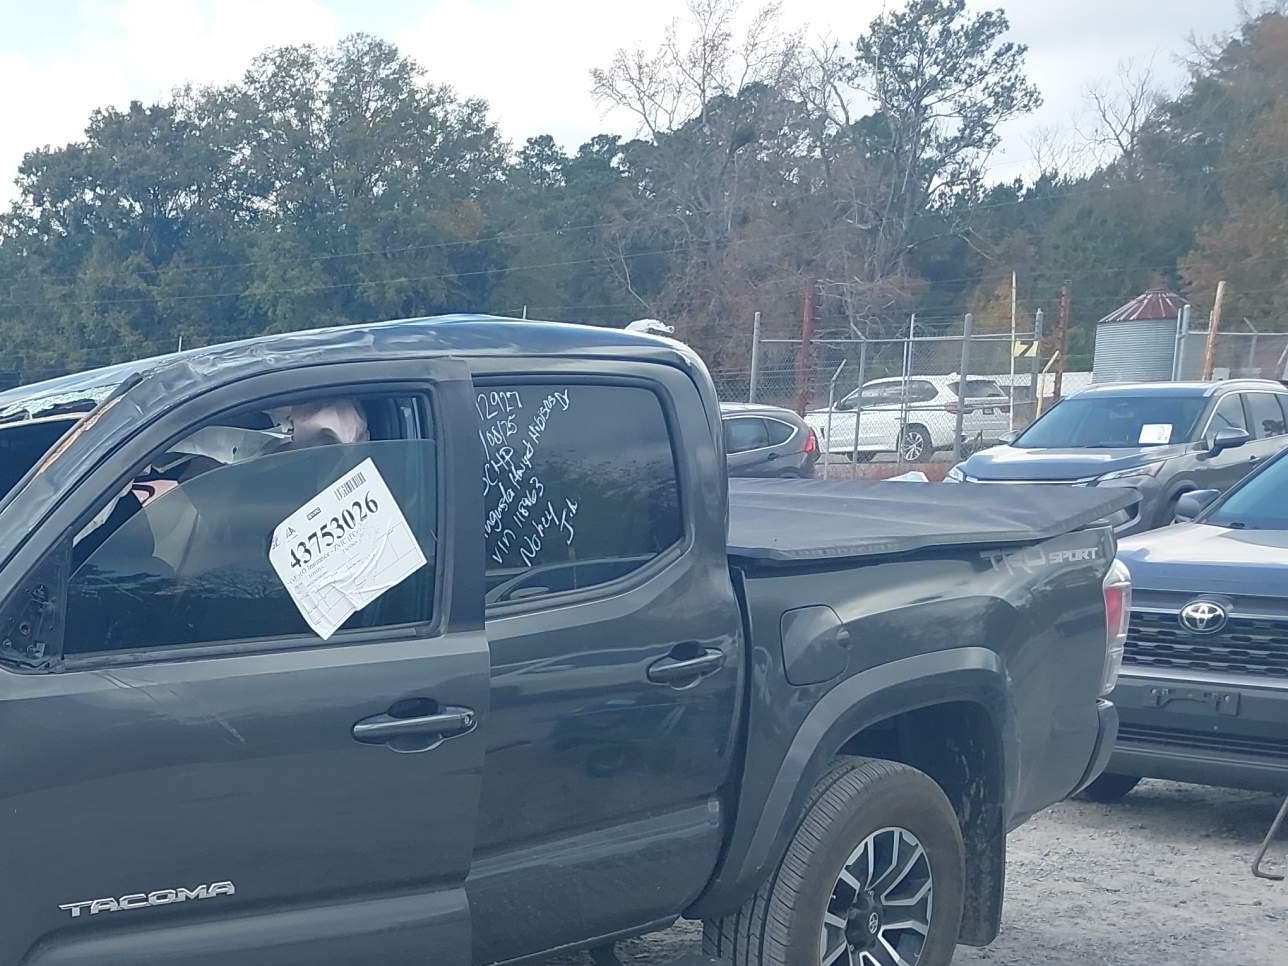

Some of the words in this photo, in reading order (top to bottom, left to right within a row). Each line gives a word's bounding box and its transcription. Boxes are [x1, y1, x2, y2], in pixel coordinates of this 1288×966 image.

[289, 491, 379, 569] 43753026
[520, 534, 543, 567] No
[1048, 547, 1098, 563] SPORT
[58, 880, 235, 918] TACOMA
